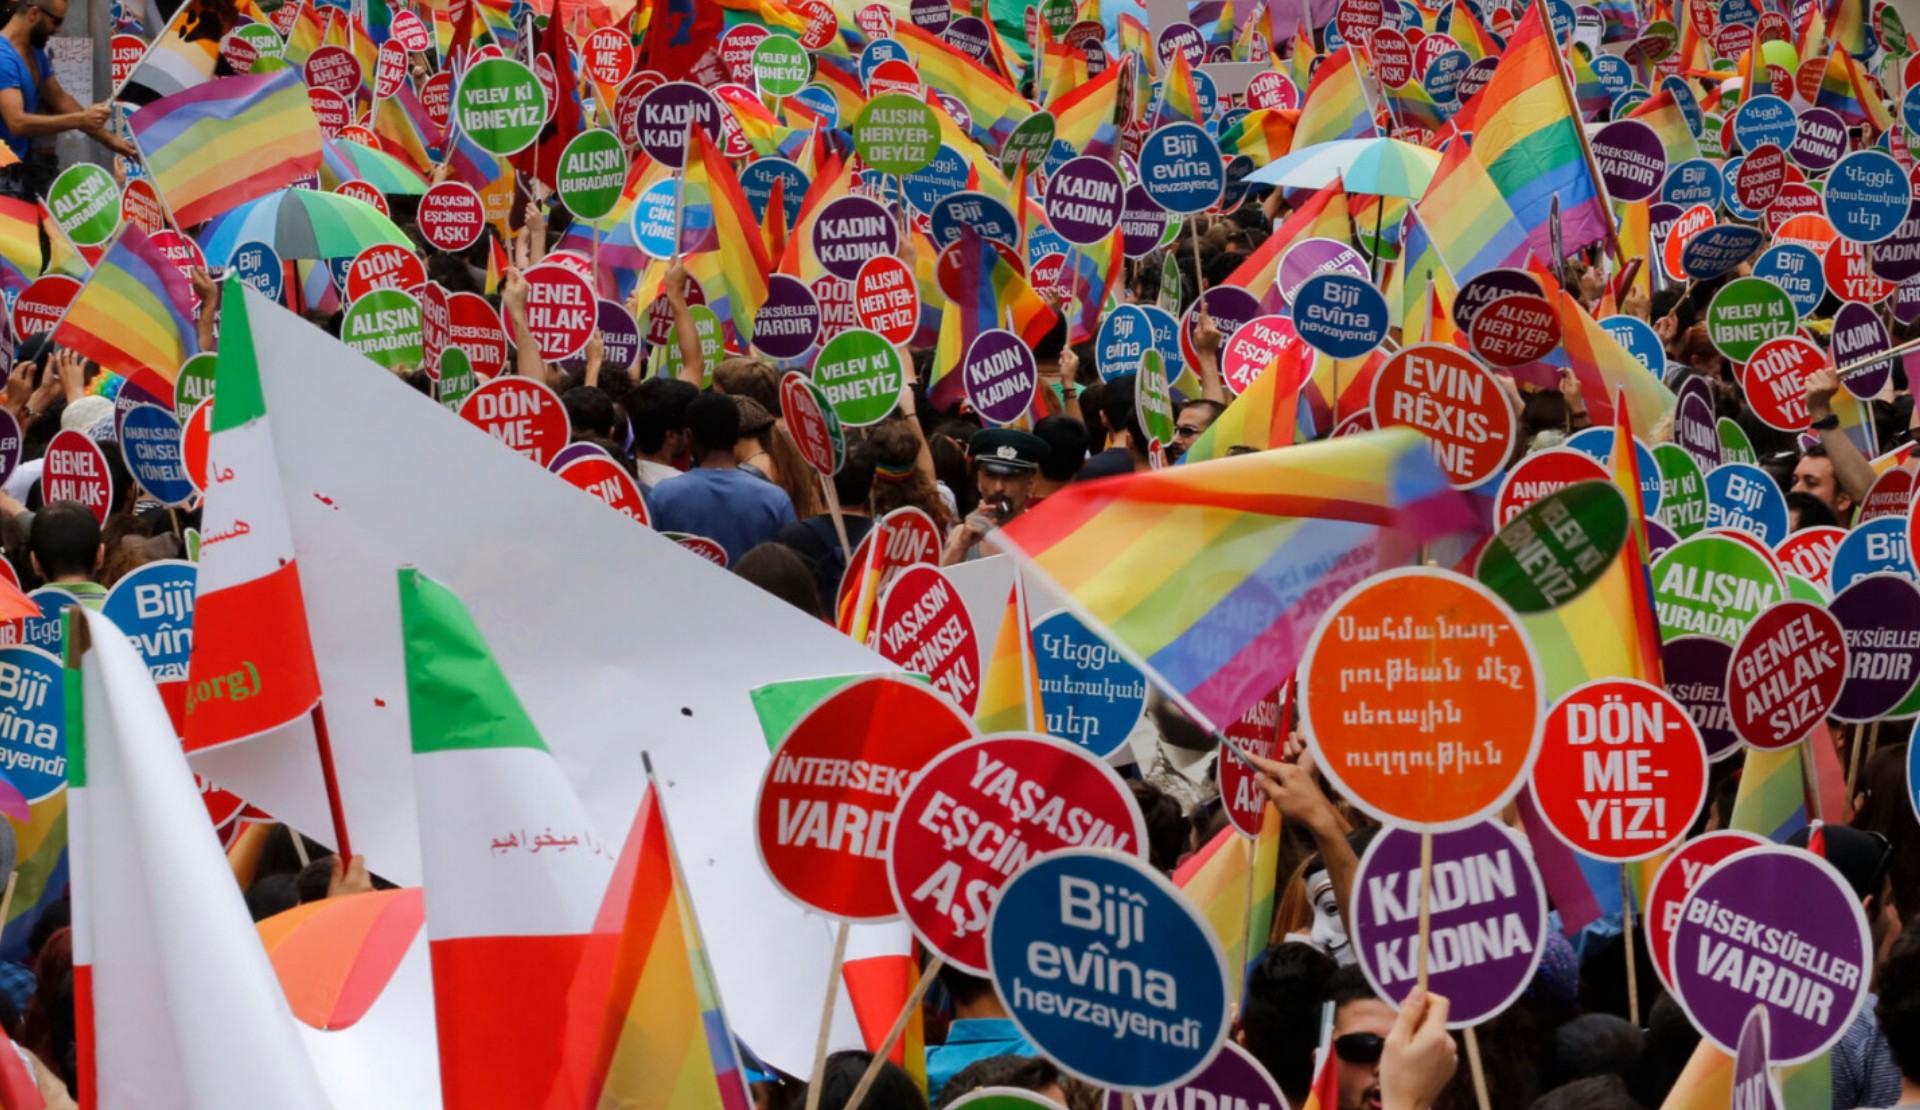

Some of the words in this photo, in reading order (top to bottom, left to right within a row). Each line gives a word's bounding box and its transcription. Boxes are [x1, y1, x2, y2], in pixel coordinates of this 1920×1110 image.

[112, 48, 143, 60] LIŞIN
[592, 34, 628, 50] DÖN-
[1160, 31, 1197, 54] KADIN
[309, 52, 350, 71] GENEL
[757, 53, 788, 66] VELEV
[466, 84, 509, 105] VELEV
[515, 81, 532, 101] Kİ
[1251, 77, 1285, 96] DÖN-
[464, 106, 541, 131] İBNEYİZ
[869, 108, 925, 125] ALIŞIN
[1800, 118, 1843, 145] KADIN
[869, 146, 925, 162] DEYİZ!
[1162, 136, 1199, 159] Bijî
[566, 149, 621, 175] ALIŞIN
[1152, 158, 1211, 179] evîna
[1745, 152, 1782, 171] YAŞASIN
[561, 171, 624, 193] BURADAYIZ
[1054, 174, 1118, 203] KADIN
[1682, 168, 1707, 185] Bijî
[52, 170, 109, 219] ALIŞIN
[428, 194, 474, 208] YAŞASIN
[1748, 184, 1777, 204] AŞK!
[424, 208, 478, 224] EŞCİNSEL
[949, 201, 983, 221] Bijî
[1050, 199, 1114, 228] KADINA
[1677, 210, 1711, 238] DÖN-
[1848, 207, 1881, 231] սեր
[433, 224, 470, 242] AŞK!
[820, 215, 887, 239] KADIN
[238, 249, 262, 269] Bijî
[357, 247, 409, 280] DÖN-
[1776, 252, 1806, 274] Bijî
[245, 269, 270, 289] vîna
[864, 266, 904, 290] ALIŞIN
[1323, 281, 1361, 307] Bijî
[352, 306, 420, 336] ALIŞIN
[530, 308, 593, 332] HLAK-
[871, 312, 913, 334] DEYİZ!
[1307, 302, 1371, 328] evîna
[1495, 304, 1553, 328] ALIŞIN
[1717, 304, 1764, 321] VELEV
[1768, 300, 1785, 318] Kİ
[753, 318, 812, 337] VARDIR
[1112, 315, 1134, 337] Bijî
[1714, 320, 1790, 345] İBNEYİZ
[1834, 322, 1882, 355] KADIN
[1480, 336, 1540, 359] DEYİZ!
[820, 358, 868, 382] VELEV
[872, 349, 889, 369] Kİ
[968, 345, 1023, 386] KADIN
[1752, 342, 1809, 382] DÖN-
[819, 373, 900, 405] İBNEYİZ
[975, 372, 1032, 411] KADINA
[1403, 352, 1484, 405] EVIN
[477, 388, 552, 421] DÖN-
[1392, 390, 1504, 444] RÊXIS-
[49, 449, 99, 477] GENEL
[49, 480, 107, 507] AHLAK-
[1724, 473, 1765, 510] Bijî
[1658, 562, 1774, 613] ALIŞIN
[881, 577, 951, 655] YAŞASIN
[1735, 612, 1825, 690] GENEL
[1745, 640, 1841, 725] AHLAK-
[1045, 706, 1100, 745] սեր
[1566, 695, 1682, 746] DÖN-
[1769, 685, 1827, 741] SIZ!
[1582, 749, 1669, 793] ME-
[968, 750, 1132, 851] YAŞASIN
[1577, 796, 1668, 841] YİZ!
[917, 790, 1046, 879] EŞCİN
[1368, 849, 1516, 927] KADIN
[1058, 873, 1150, 950] Bijî
[1374, 913, 1535, 986] KADINA
[1685, 896, 1862, 993] BİSEKSÜELLER
[1024, 939, 1178, 1011] evîna
[1694, 934, 1837, 1028] VARDIR
[1011, 978, 1203, 1053] hevzayendî
